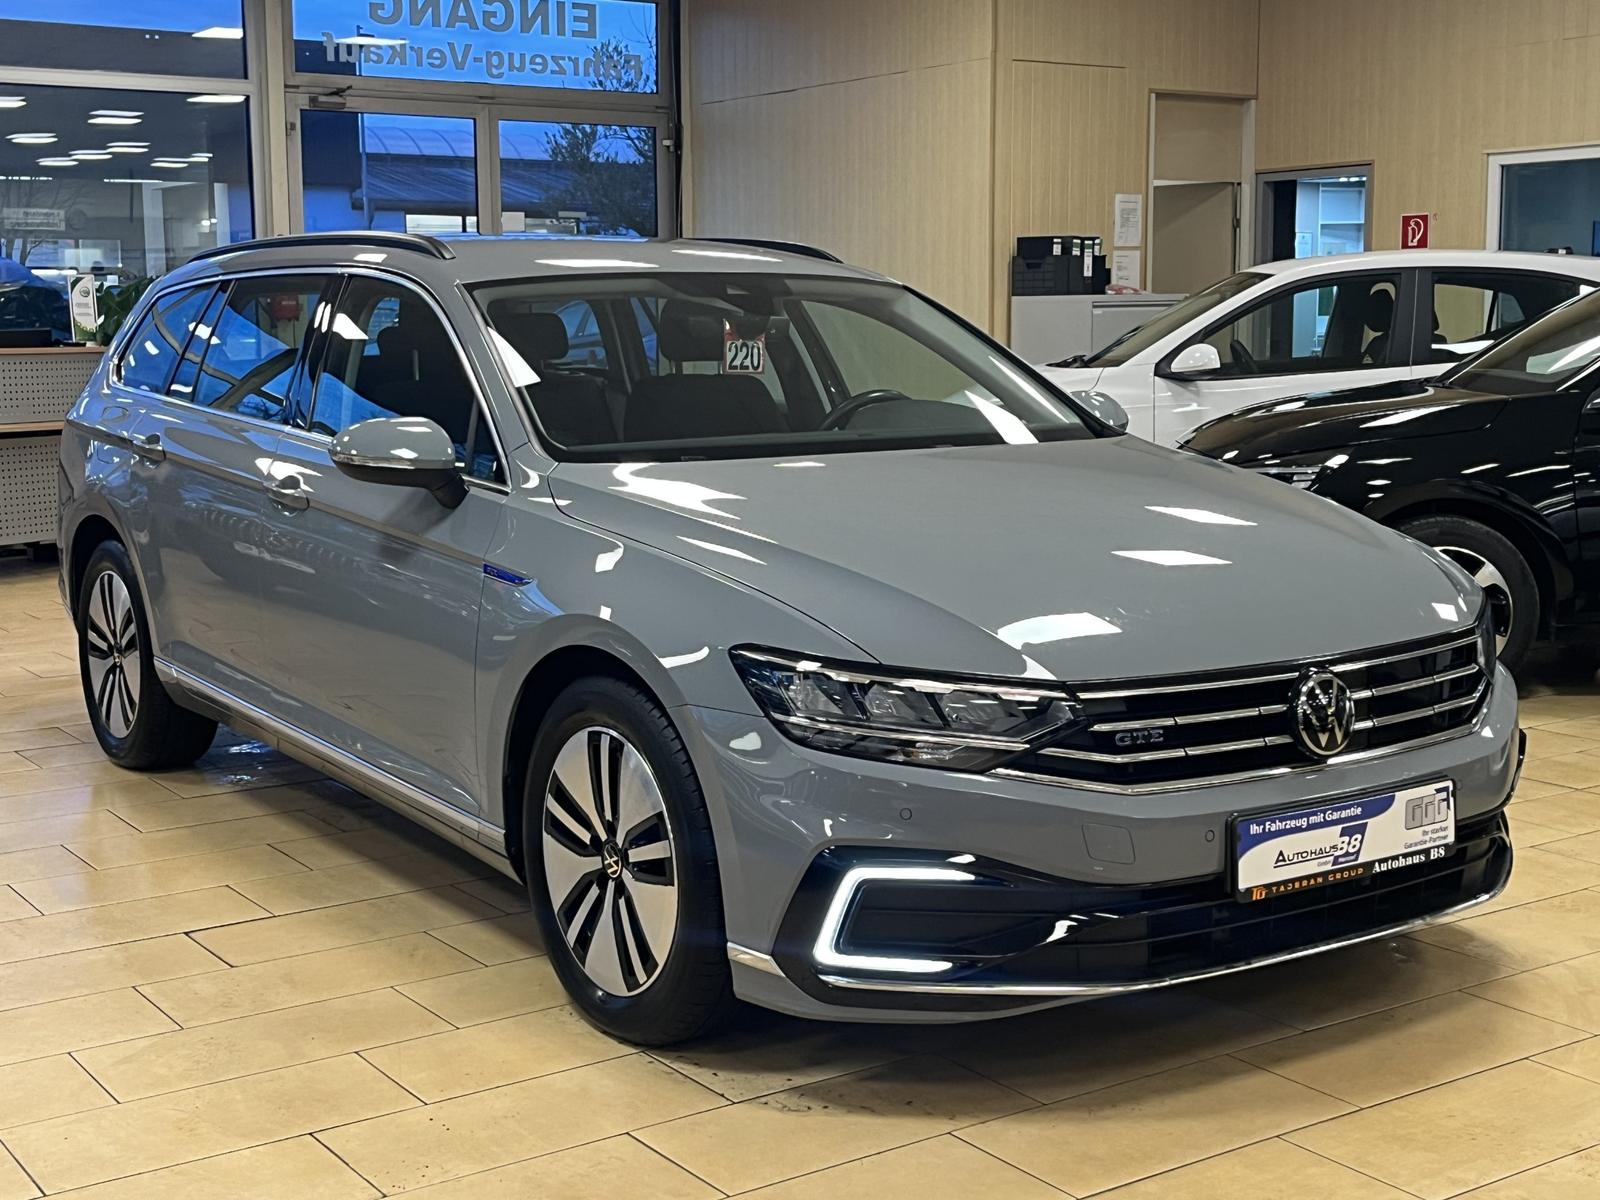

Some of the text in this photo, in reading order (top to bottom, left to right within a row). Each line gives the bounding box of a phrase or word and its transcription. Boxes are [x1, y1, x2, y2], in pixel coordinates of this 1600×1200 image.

[728, 341, 761, 371] 220
[1115, 729, 1164, 746] GTE
[1250, 806, 1362, 835] Ihr Fahrzeug mit Garantie
[1372, 853, 1426, 873] Autohaus
[1328, 868, 1364, 880] GROUP
